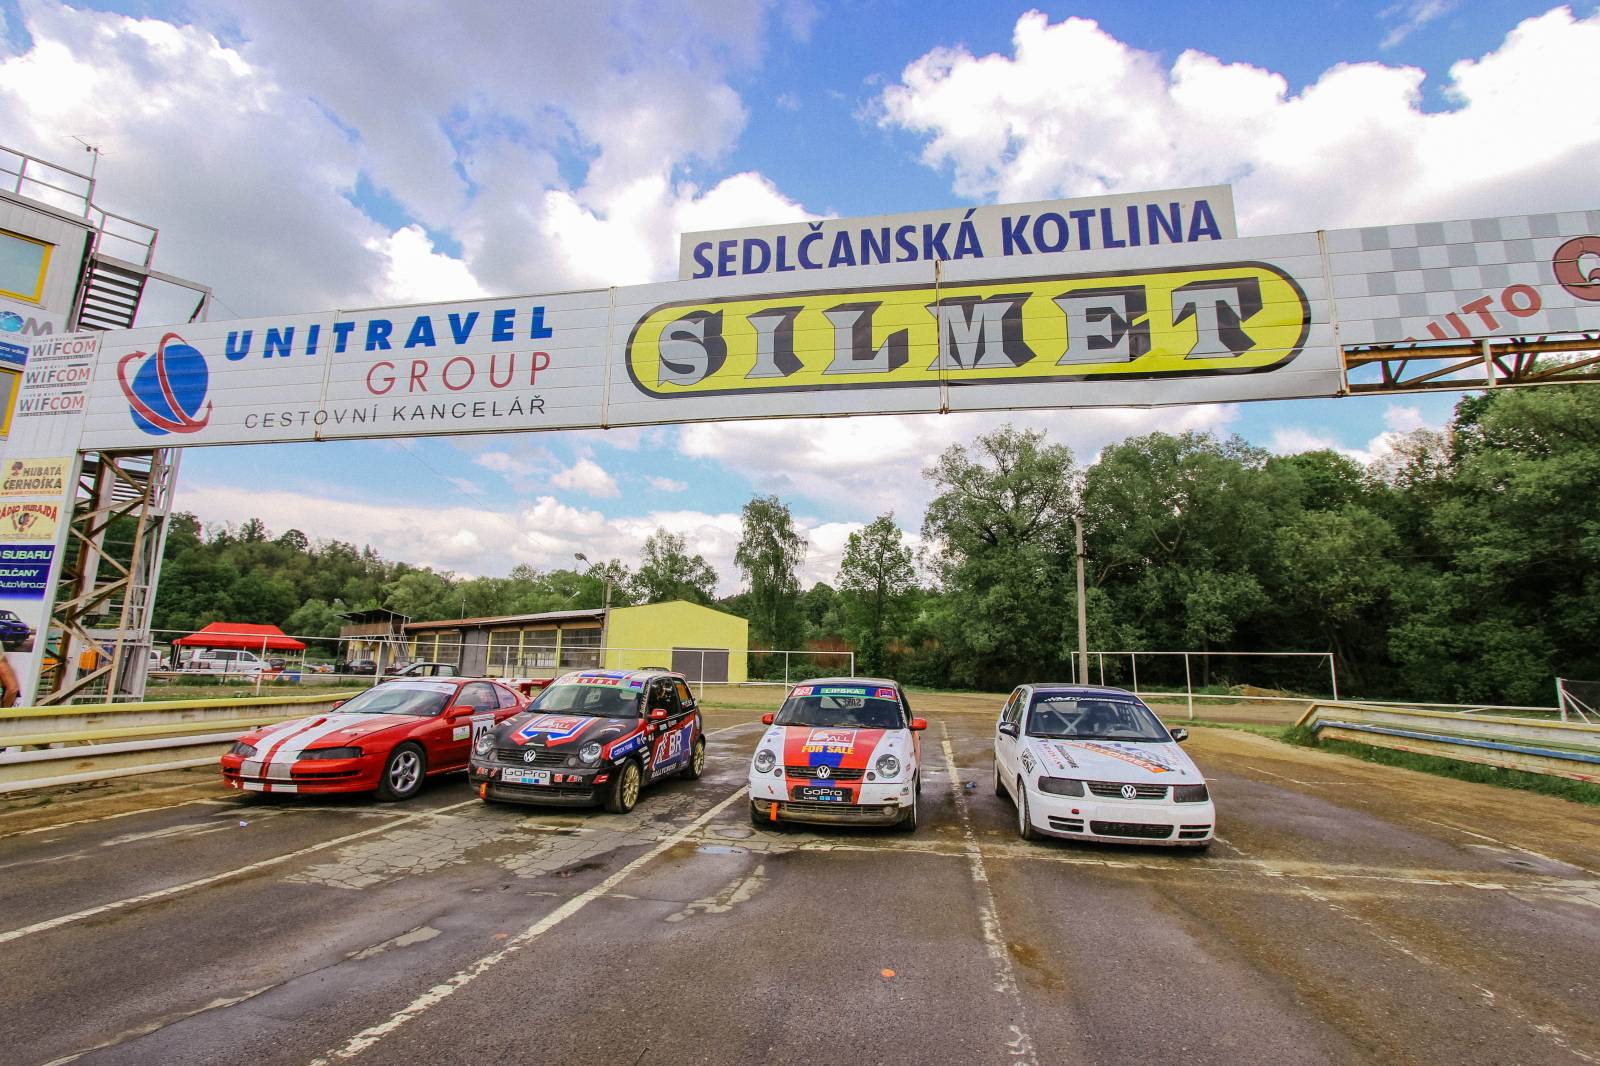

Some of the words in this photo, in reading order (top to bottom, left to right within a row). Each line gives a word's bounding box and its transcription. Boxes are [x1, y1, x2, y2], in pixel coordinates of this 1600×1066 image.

[692, 208, 983, 279] SEDLČANSKÁ
[1001, 199, 1223, 256] KOTLINA
[1404, 284, 1542, 340] UTO
[225, 306, 553, 361] UNITRAVEL
[657, 276, 1263, 388] SILMET
[33, 340, 97, 357] WIFCOM
[26, 367, 91, 385] WIFCOM
[366, 351, 551, 395] GROUP
[20, 395, 86, 412] WIFCOM
[244, 404, 378, 429] CESTOVNÍ
[392, 394, 546, 422] KANCELÁŘ
[2, 550, 52, 560] SUBARU
[801, 745, 823, 753] FOR
[827, 745, 855, 755] SALE
[504, 768, 547, 778] GoPro
[803, 787, 843, 796] GoPro
